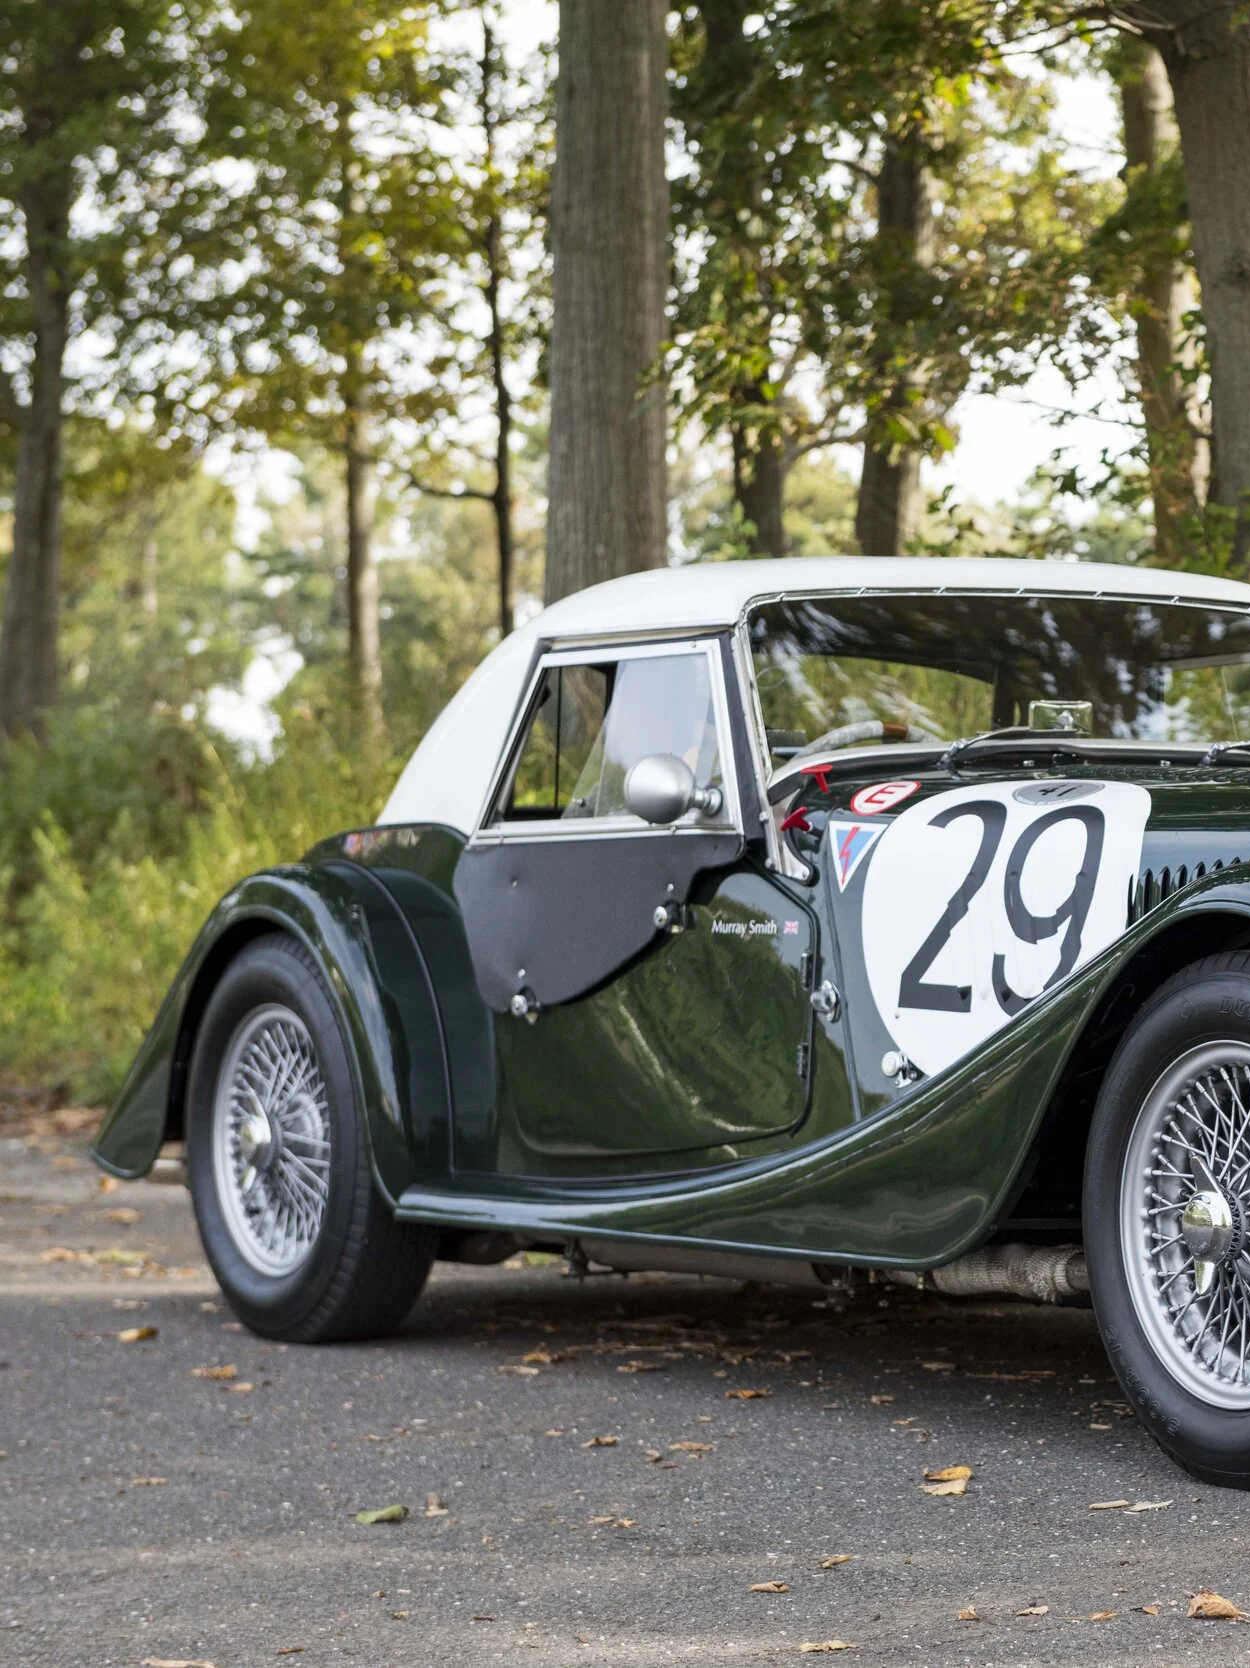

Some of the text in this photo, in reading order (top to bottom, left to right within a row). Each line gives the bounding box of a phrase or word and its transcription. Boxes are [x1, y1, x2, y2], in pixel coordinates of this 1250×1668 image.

[711, 919, 777, 938] Murray Smith
[898, 800, 1106, 1017] 29
